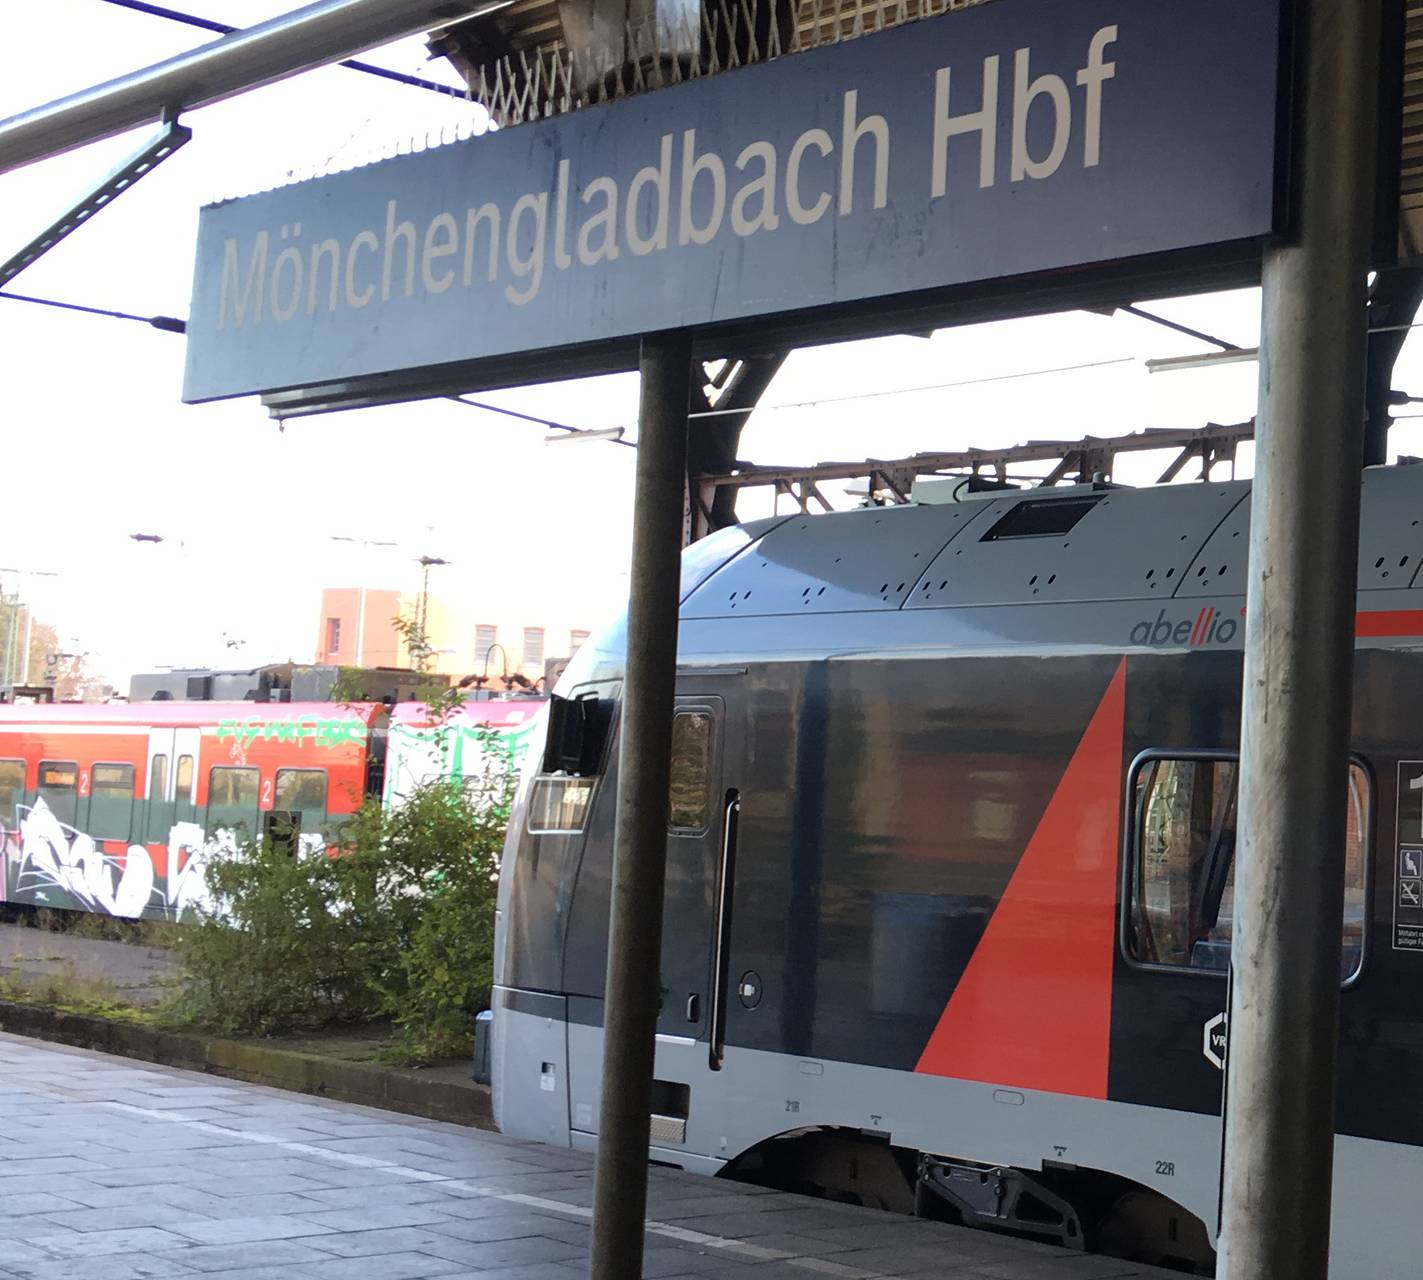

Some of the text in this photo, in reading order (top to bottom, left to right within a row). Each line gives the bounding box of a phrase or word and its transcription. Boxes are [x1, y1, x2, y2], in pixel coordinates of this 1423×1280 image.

[216, 24, 1119, 332] Mönchengladbach Hbf
[1129, 608, 1238, 646] abellio
[80, 773, 89, 793] 2
[262, 780, 272, 803] 2
[1155, 1160, 1175, 1176] 22R
